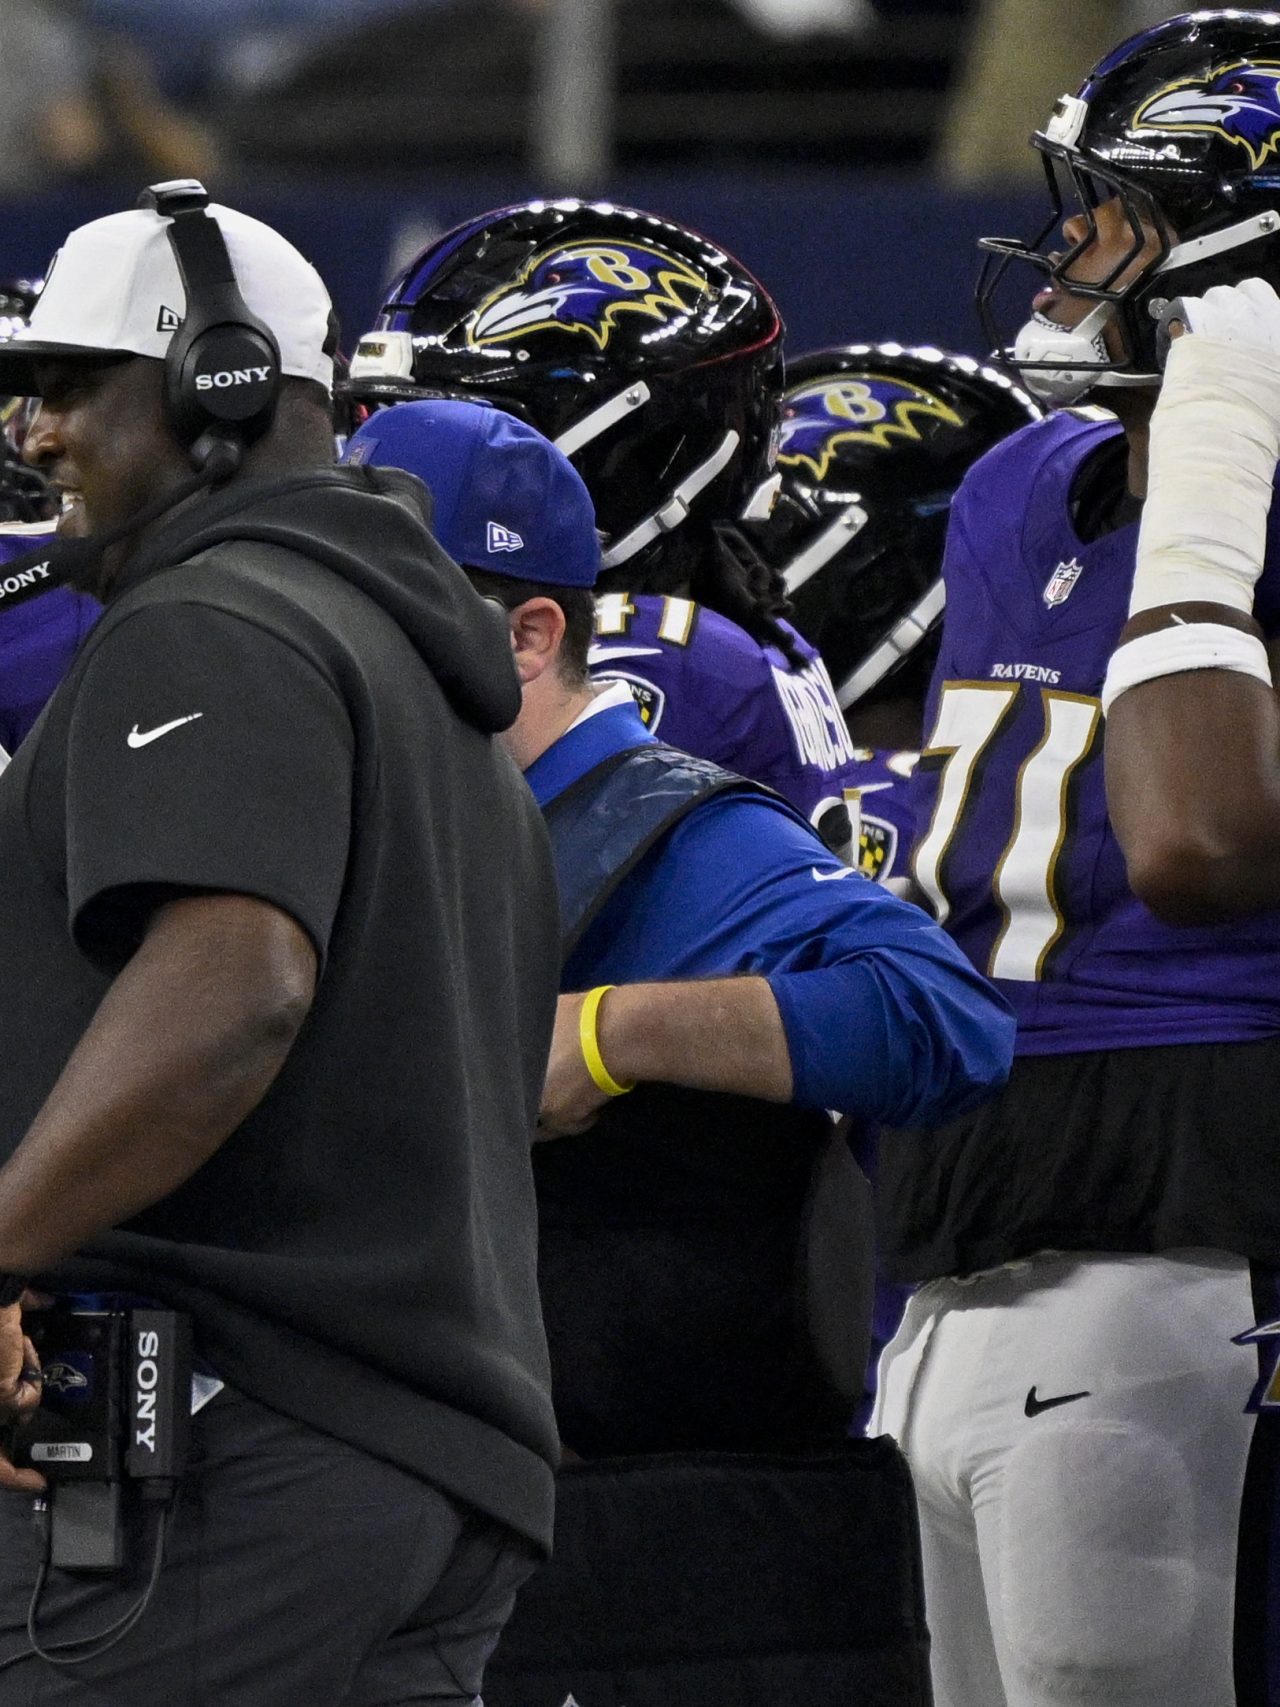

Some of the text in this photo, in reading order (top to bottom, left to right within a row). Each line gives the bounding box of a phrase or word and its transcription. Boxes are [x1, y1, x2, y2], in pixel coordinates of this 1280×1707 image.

[195, 366, 271, 390] SONY
[990, 663, 1062, 684] RAVENS
[910, 679, 1104, 982] 71
[136, 1330, 159, 1453] SONY
[46, 1445, 81, 1458] MARTIN
